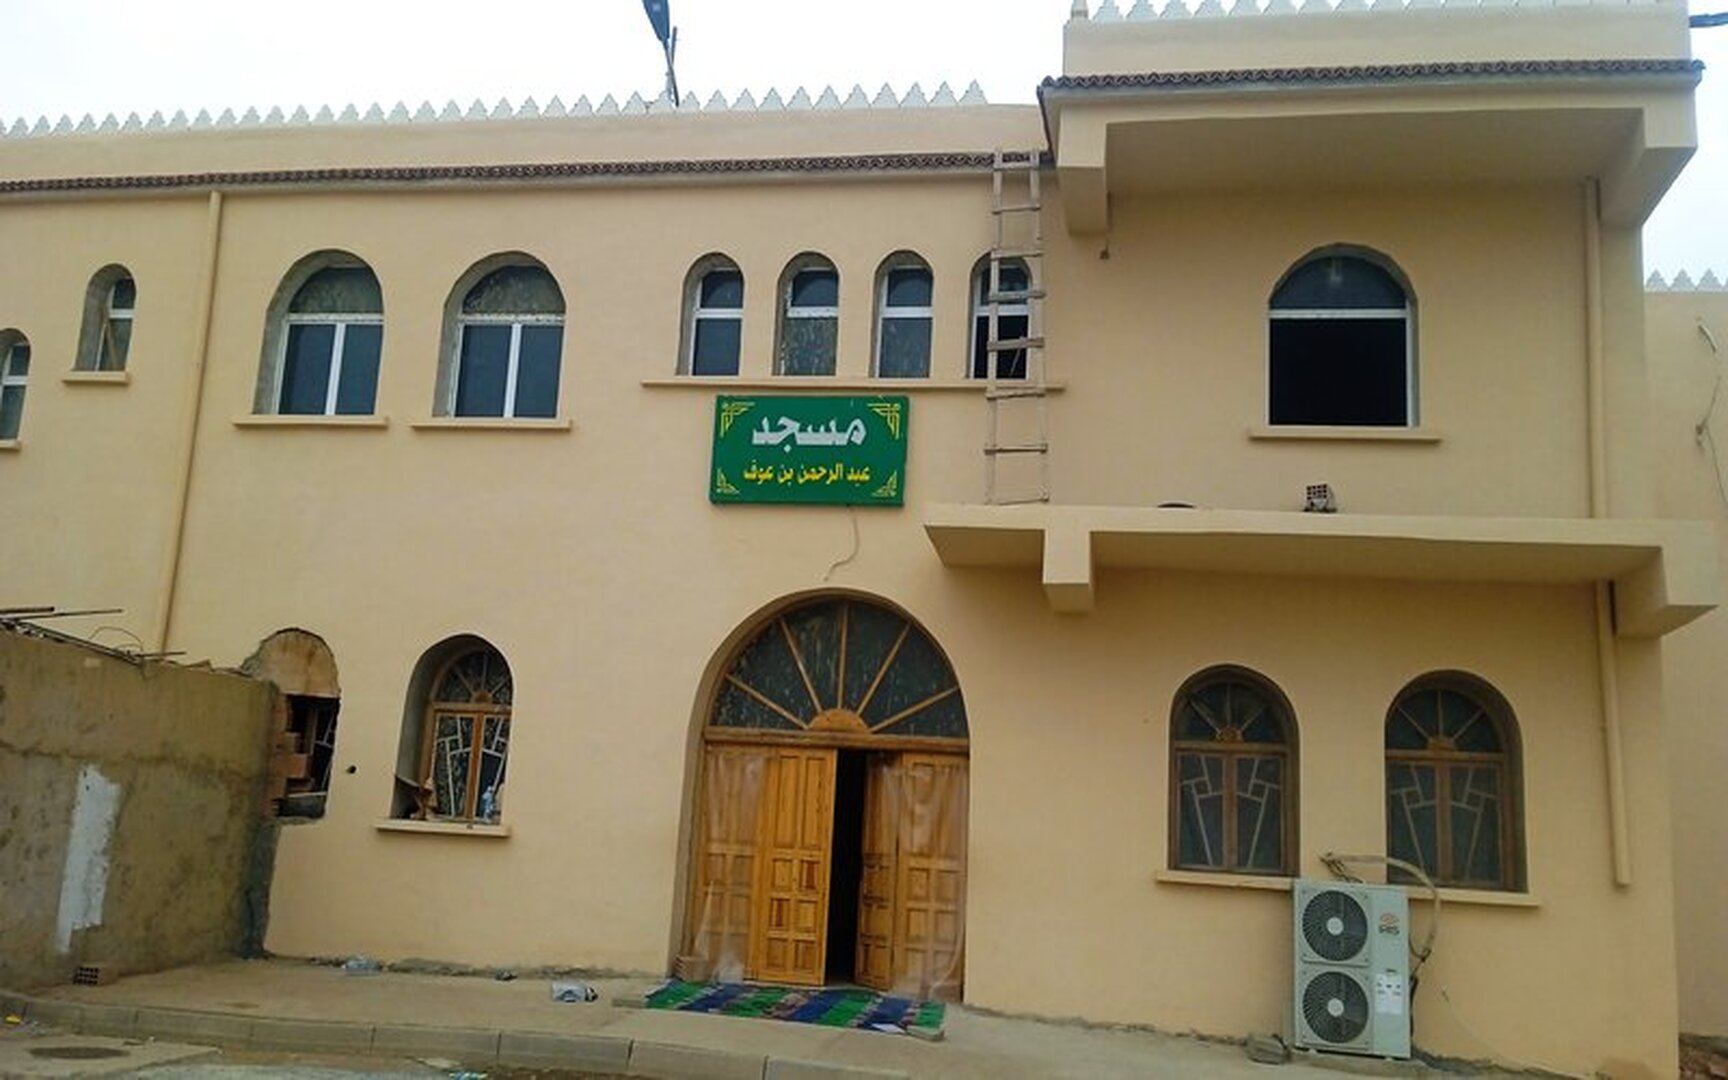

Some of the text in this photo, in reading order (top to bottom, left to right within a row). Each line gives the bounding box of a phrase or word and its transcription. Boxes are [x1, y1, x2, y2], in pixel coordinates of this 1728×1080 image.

[752, 416, 867, 453] مسجد
[743, 459, 871, 487] عبد الرحمن بن عوف
